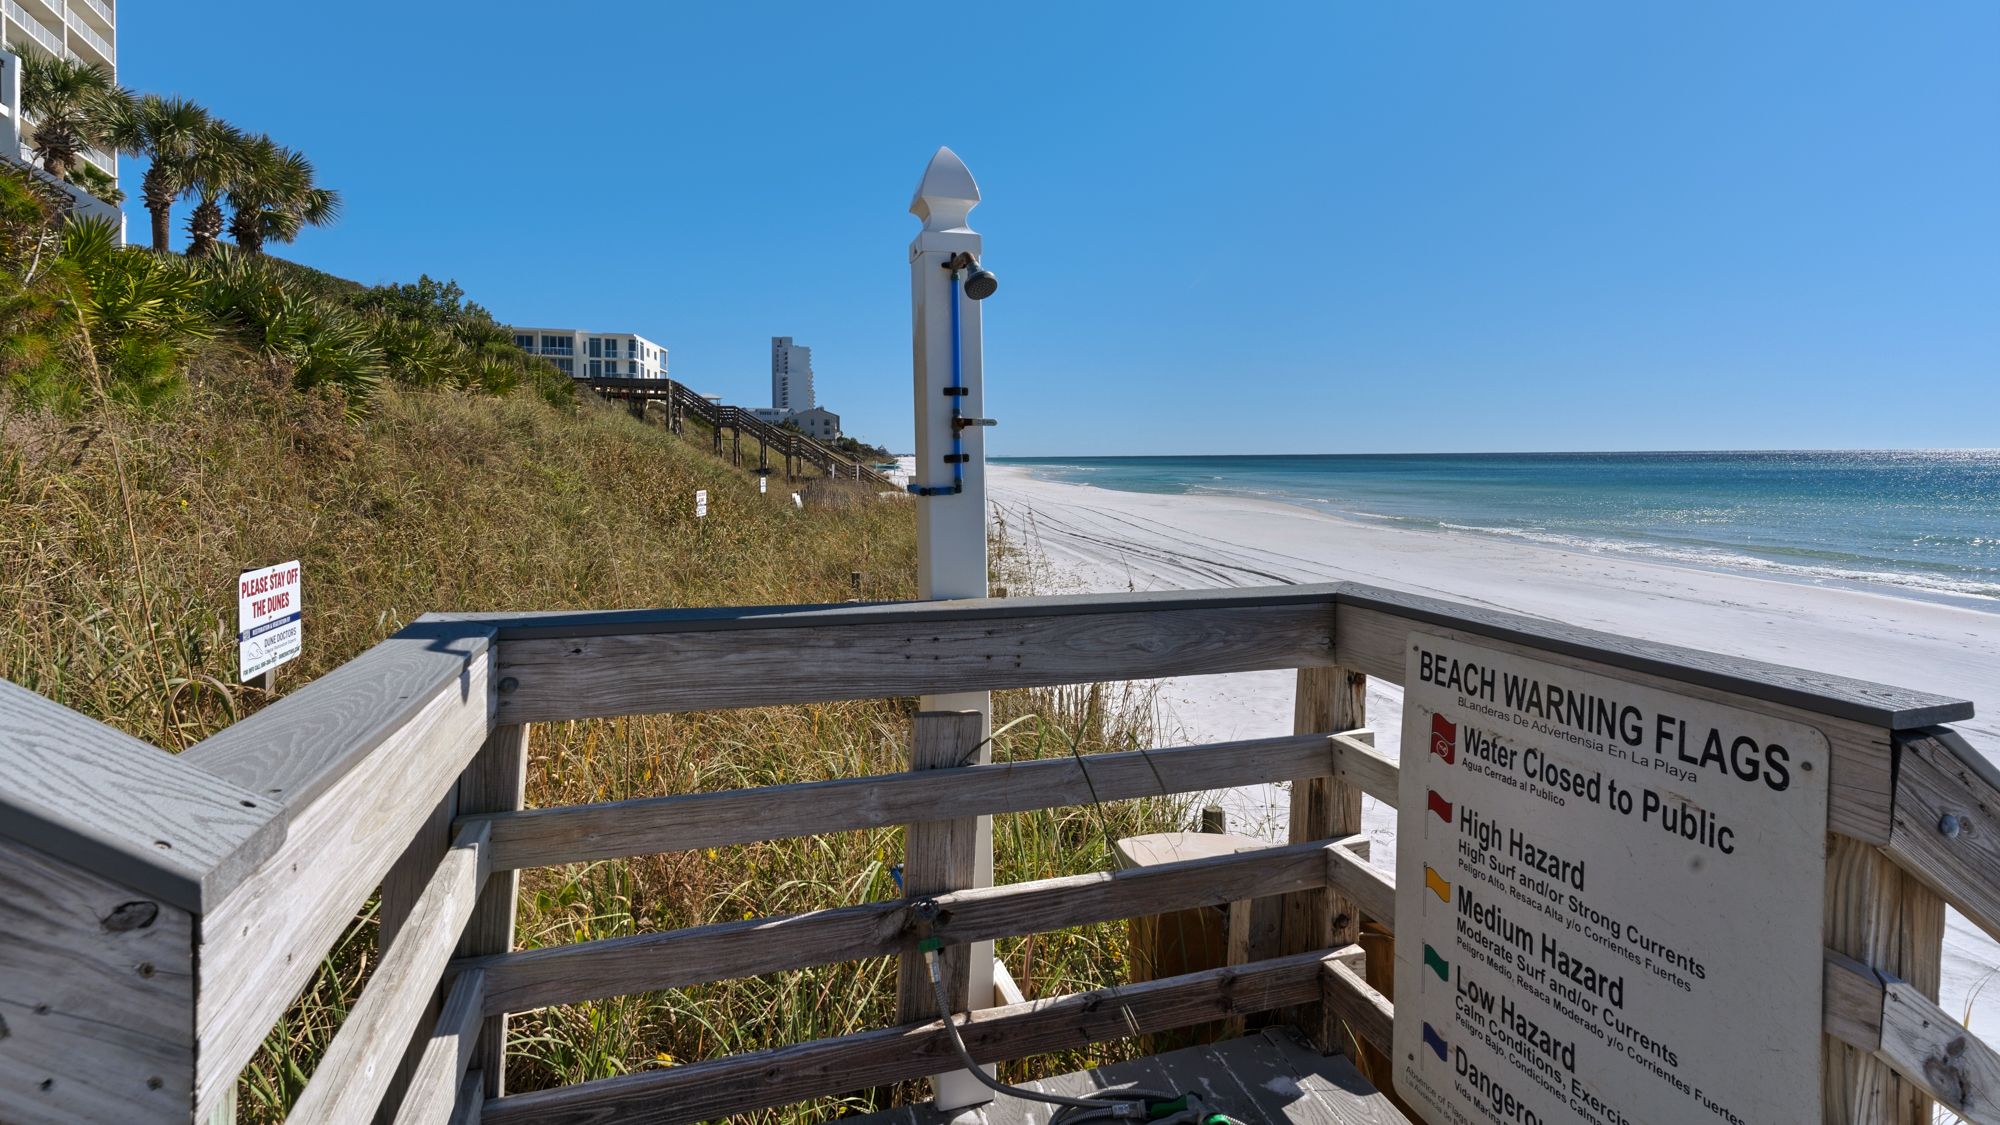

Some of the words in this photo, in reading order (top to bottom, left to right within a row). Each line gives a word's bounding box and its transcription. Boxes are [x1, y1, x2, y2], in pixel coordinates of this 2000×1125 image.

[242, 576, 268, 599] PLEASE
[270, 571, 285, 590] STAY
[287, 568, 298, 585] OFF
[252, 599, 266, 619] THE
[268, 591, 289, 613] DUNES
[1420, 650, 1496, 702] BEACH
[1503, 672, 1643, 747] WARNING
[1655, 713, 1790, 792] FLAGS
[1513, 714, 1529, 728] De
[1531, 719, 1604, 753] Advertensia
[1608, 744, 1627, 760] En
[1631, 751, 1649, 768] La
[1654, 758, 1698, 783] Playa
[1462, 757, 1483, 774] Agua
[1484, 766, 1517, 788] Cerrada
[1519, 781, 1527, 792] al
[1529, 783, 1566, 807] Publico
[1463, 725, 1518, 770] Water
[1523, 747, 1601, 804] Closed
[1608, 779, 1633, 815] to
[1642, 788, 1735, 855] Public
[1460, 805, 1502, 852] High
[1509, 827, 1585, 892] Hazard
[1458, 838, 1485, 865] High
[1489, 855, 1516, 881] Surf
[1519, 873, 1564, 905] and/or
[1568, 894, 1621, 940] Strong
[1626, 925, 1706, 980] Currents
[1458, 858, 1486, 881] Peligro
[1488, 874, 1508, 895] Alto,
[1509, 885, 1542, 911] Resaca
[1544, 905, 1563, 923] Alta
[1566, 917, 1581, 933] y/o
[1584, 925, 1642, 966] Corrientes
[1645, 957, 1692, 993] Fuertes
[1458, 885, 1534, 956] Medium
[1541, 932, 1624, 1010] Hazard
[1456, 917, 1513, 964] Moderate
[1516, 954, 1546, 984] Surf
[1549, 977, 1598, 1017] and/or
[1602, 1007, 1678, 1068] Currents
[1456, 936, 1485, 962] Peligro
[1516, 975, 1550, 1005] Resaca
[1553, 997, 1604, 1039] Moderado
[1607, 1034, 1624, 1052] y/o
[1627, 1046, 1690, 1096] Corrientes
[1456, 965, 1495, 1015] Low
[1501, 994, 1575, 1074] Hazard
[1455, 995, 1485, 1028] Calm
[1488, 1019, 1566, 1090] Conditions,
[1455, 1012, 1483, 1041] Peligro
[1485, 1035, 1507, 1060] Bajo,
[1508, 1053, 1567, 1104] Condiciones
[1456, 1045, 1544, 1125] Dangero
[1455, 1080, 1472, 1102] Vida
